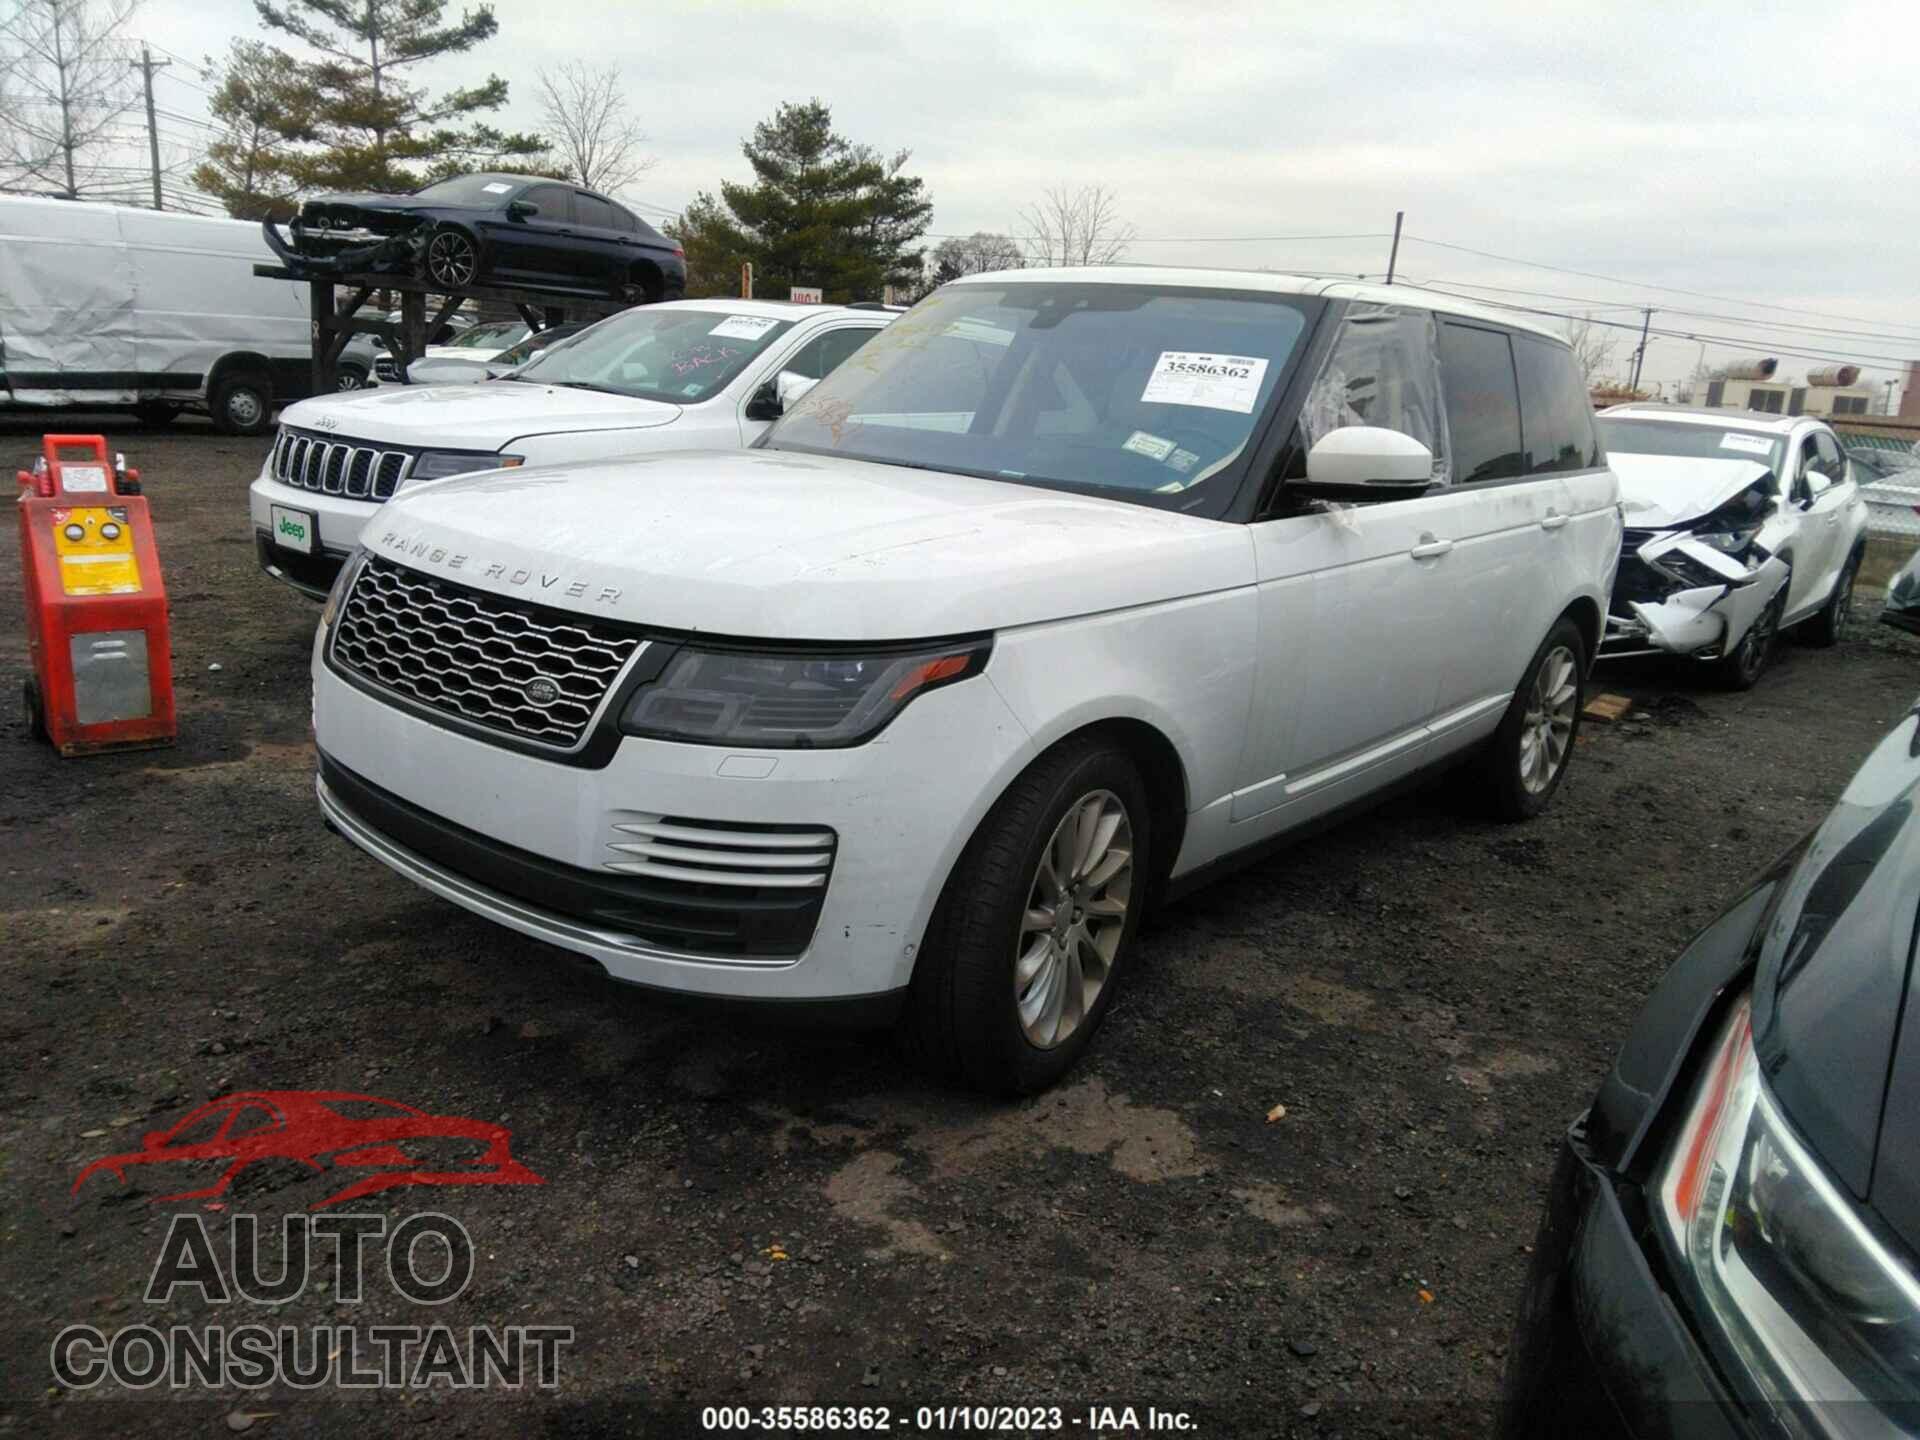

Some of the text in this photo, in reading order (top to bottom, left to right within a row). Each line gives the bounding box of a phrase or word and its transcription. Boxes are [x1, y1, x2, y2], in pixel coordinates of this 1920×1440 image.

[1164, 361, 1250, 379] 35586362
[279, 516, 305, 542] Jeep
[381, 532, 624, 605] RANGE ROVER
